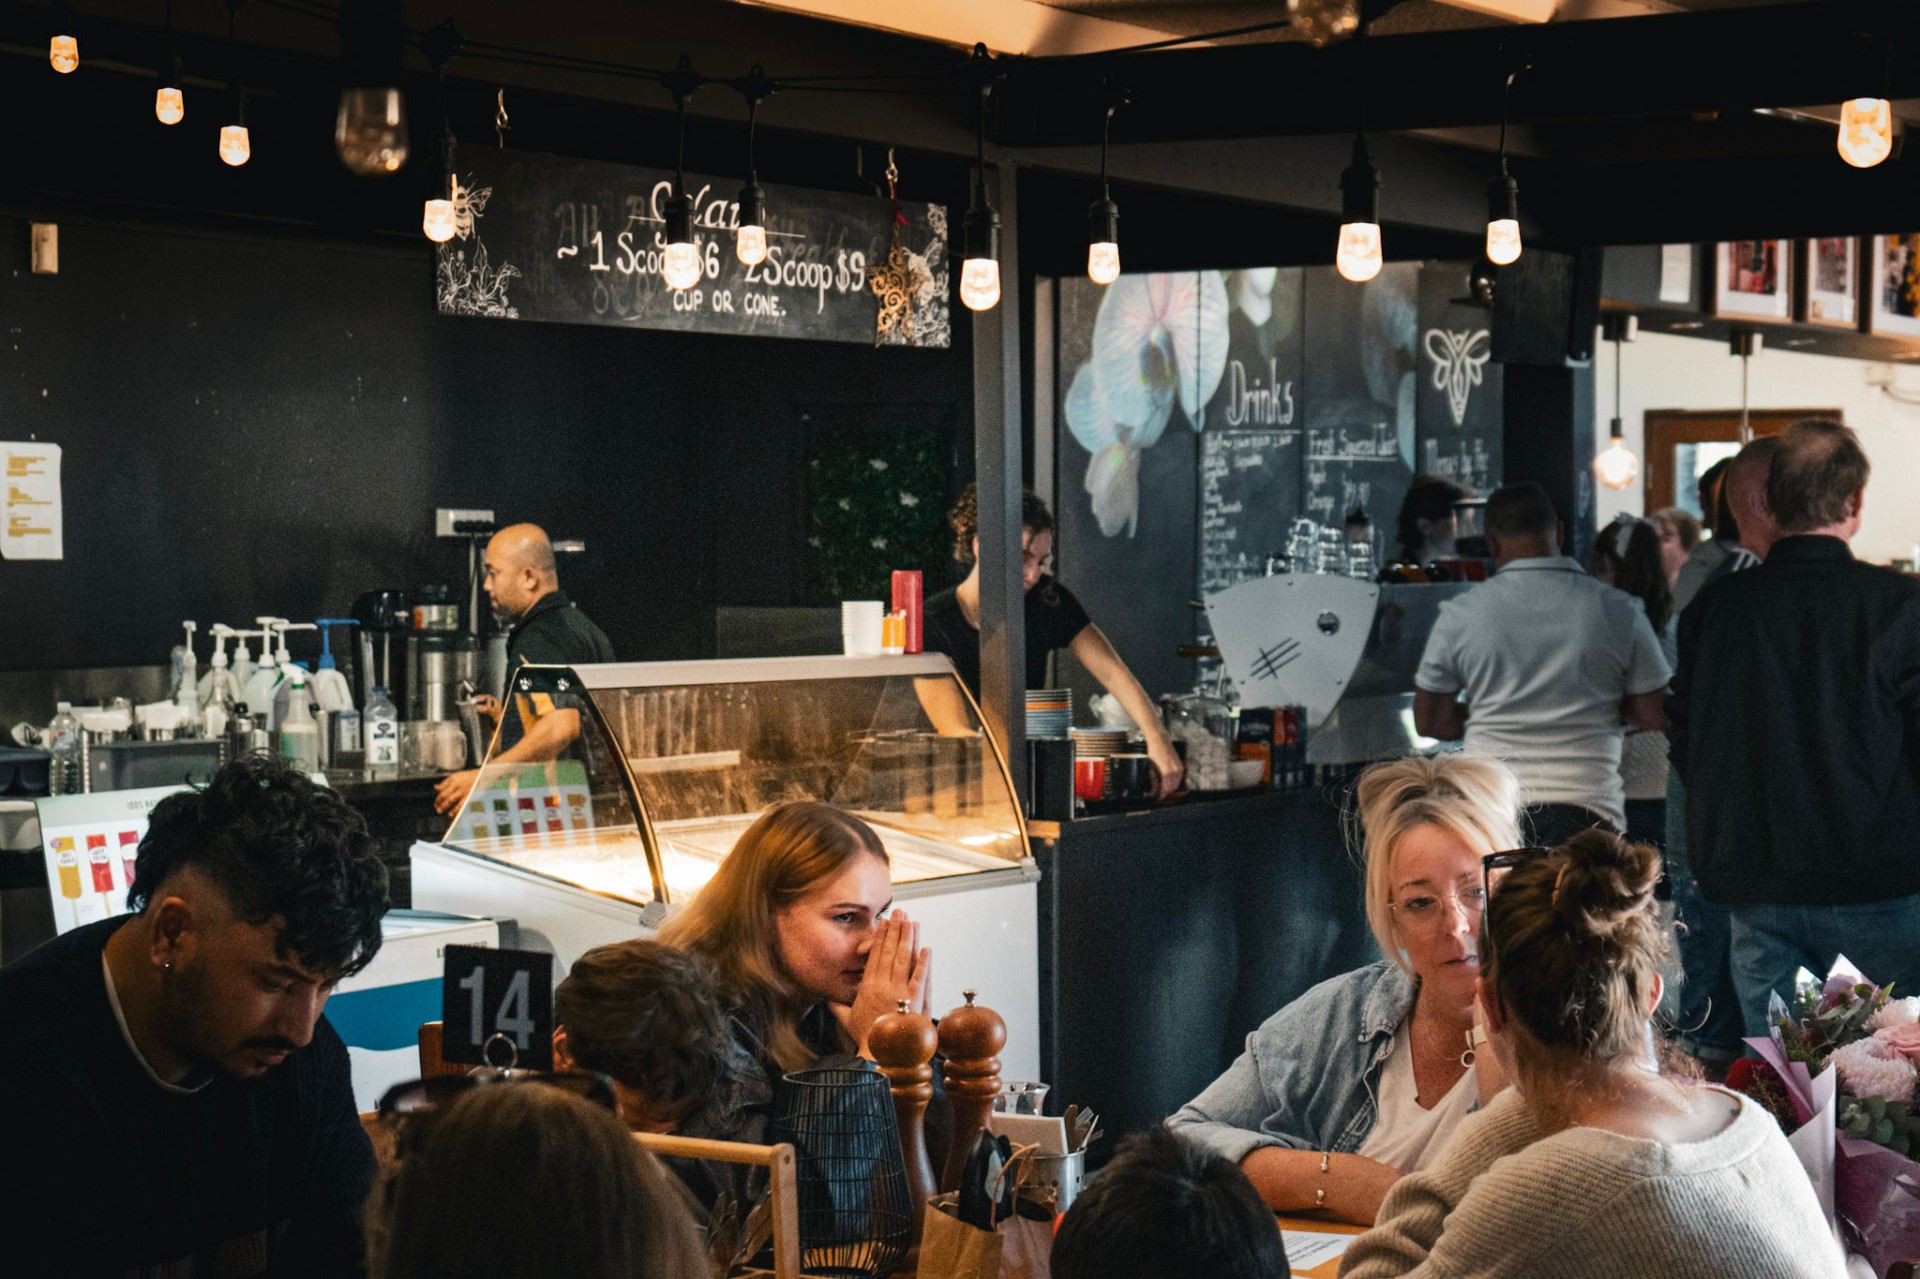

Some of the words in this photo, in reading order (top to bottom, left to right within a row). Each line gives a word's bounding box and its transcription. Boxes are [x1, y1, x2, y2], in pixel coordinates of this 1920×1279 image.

[616, 232, 672, 291] Scoo
[763, 246, 833, 314] Scoop
[835, 248, 866, 293] $9
[673, 290, 703, 311] CUP
[712, 289, 735, 313] OR
[1226, 356, 1295, 426] Drinks
[459, 966, 536, 1051] 14
